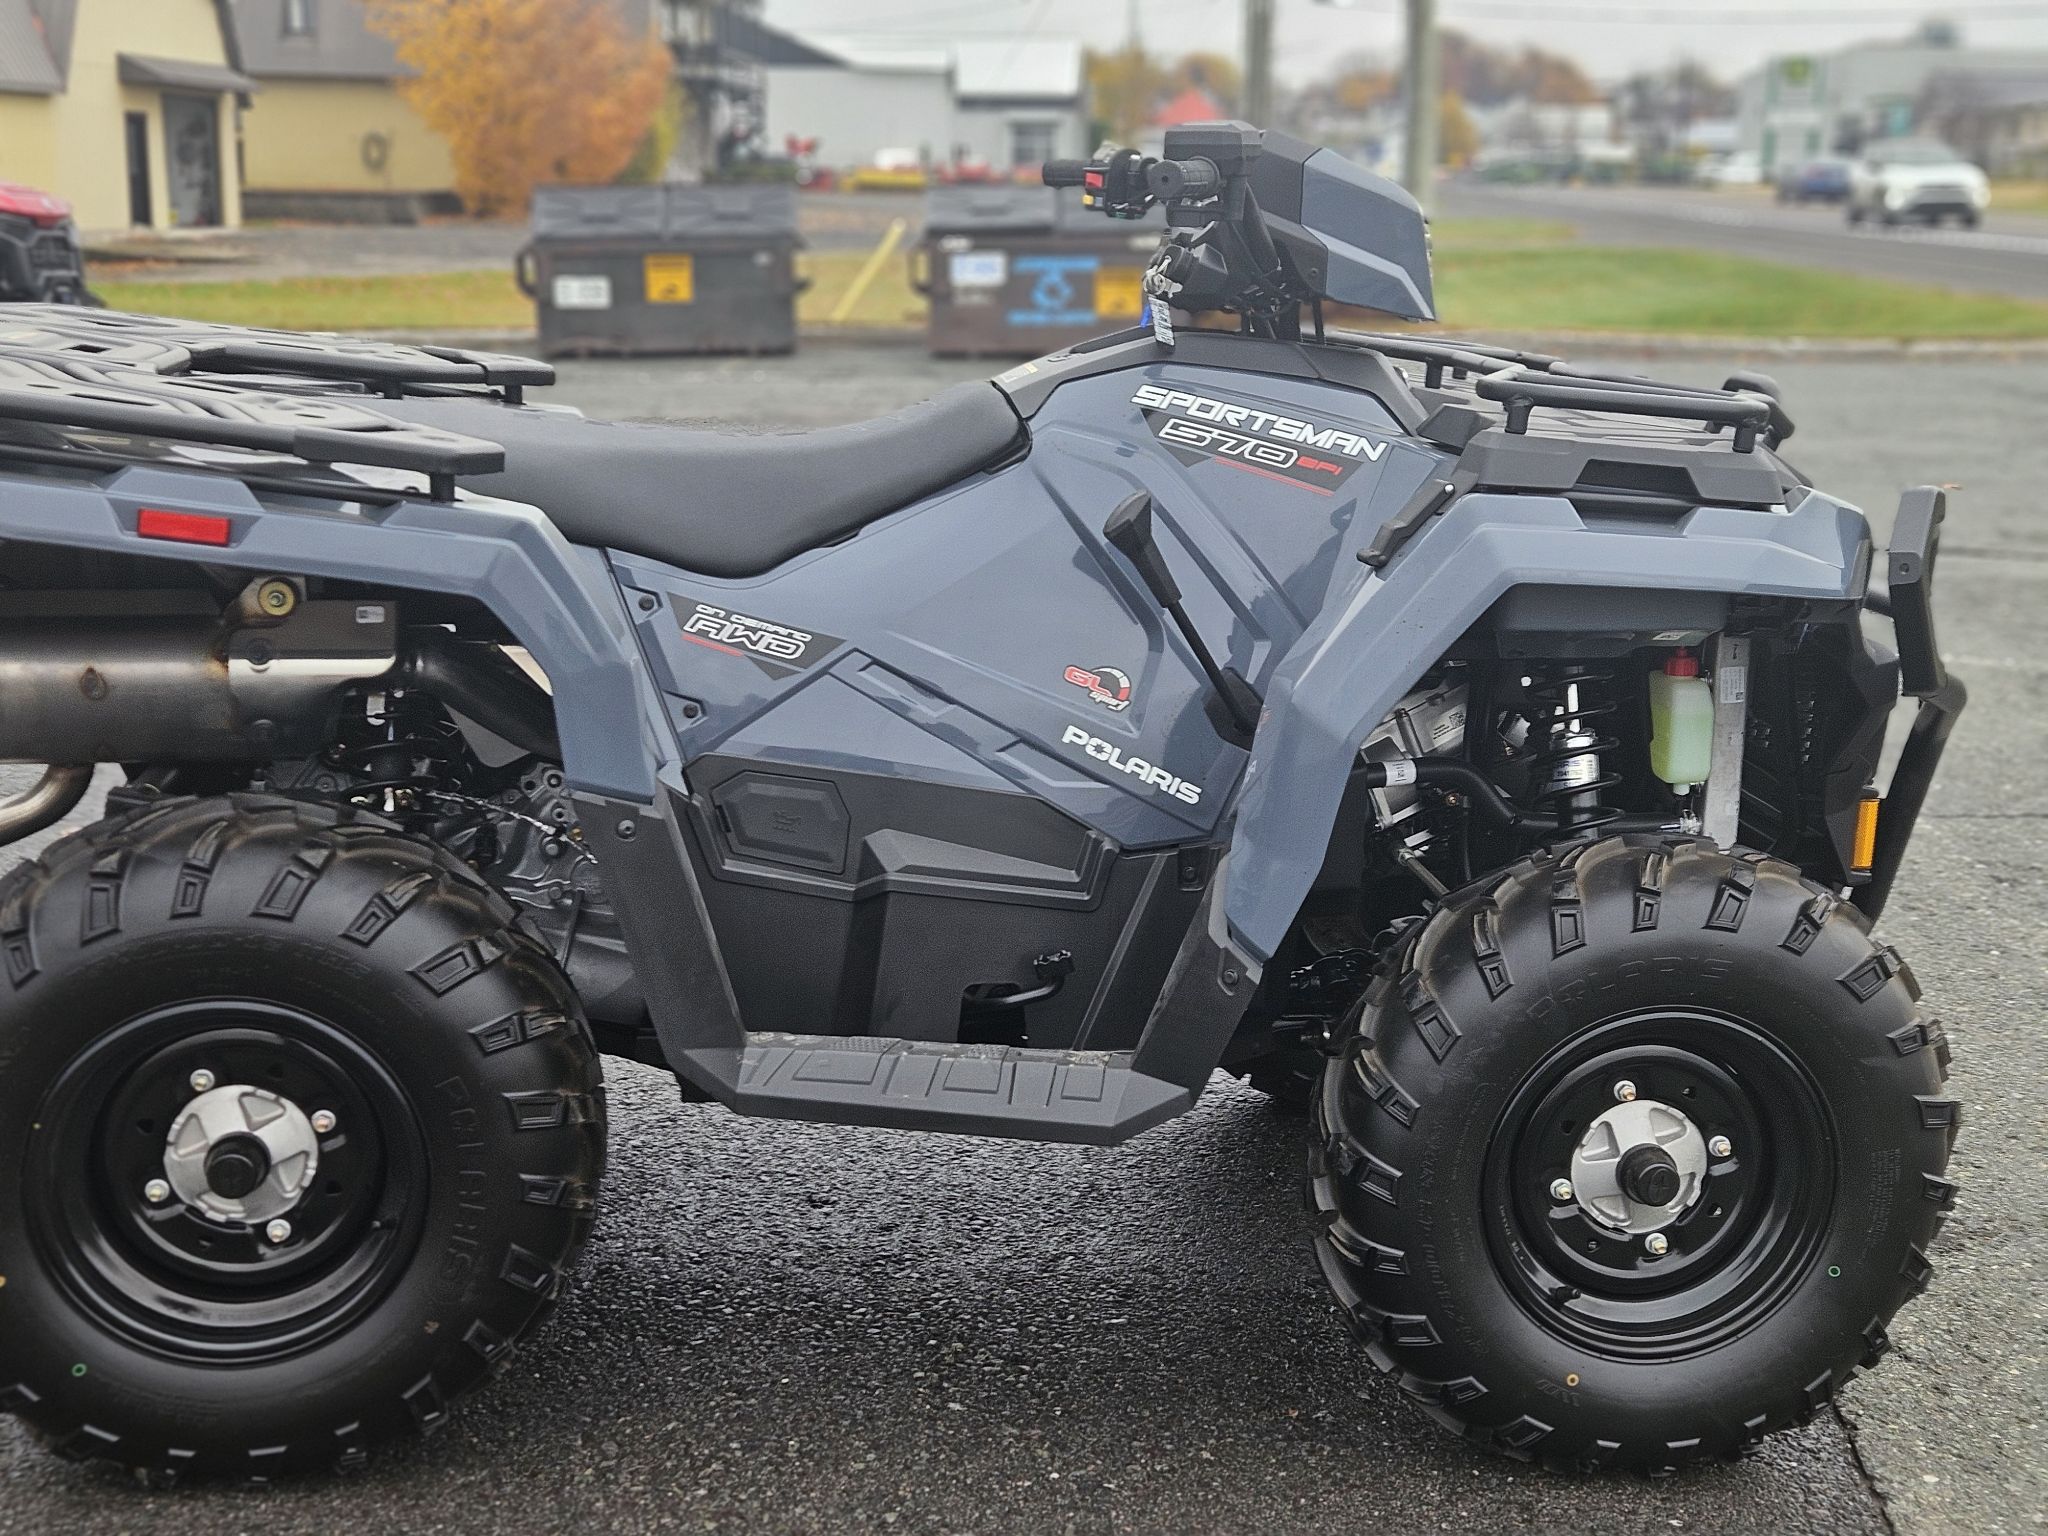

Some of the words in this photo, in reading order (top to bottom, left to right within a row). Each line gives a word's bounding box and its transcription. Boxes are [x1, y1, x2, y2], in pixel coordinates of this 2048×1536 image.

[1130, 384, 1389, 461] SPORTSMAN
[1158, 418, 1299, 469] 570
[683, 613, 806, 660] AWD
[1061, 725, 1202, 805] POLARIS
